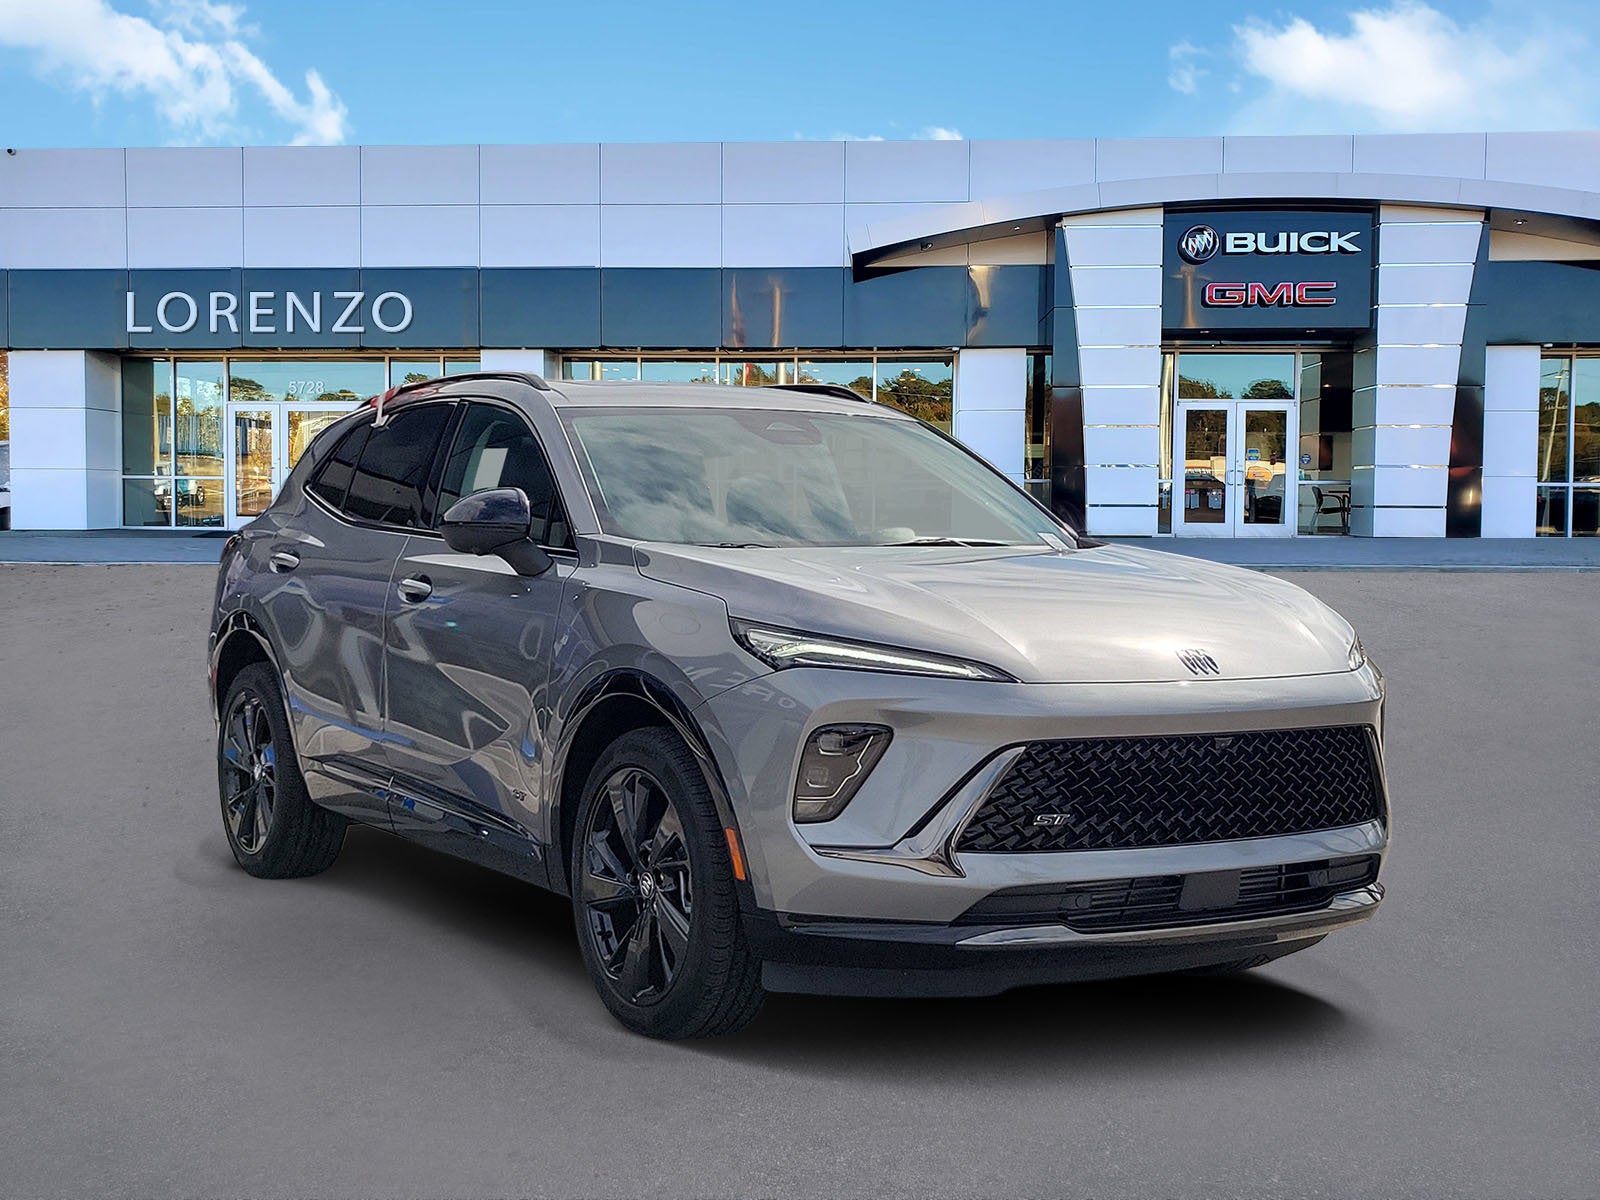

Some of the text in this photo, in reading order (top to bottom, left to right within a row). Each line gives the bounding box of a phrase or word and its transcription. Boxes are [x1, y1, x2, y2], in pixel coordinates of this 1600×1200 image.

[1224, 231, 1363, 254] BUICK
[1204, 281, 1338, 306] GMC
[126, 291, 413, 333] LORENZO
[288, 380, 325, 395] 5728
[1033, 813, 1071, 826] ST
